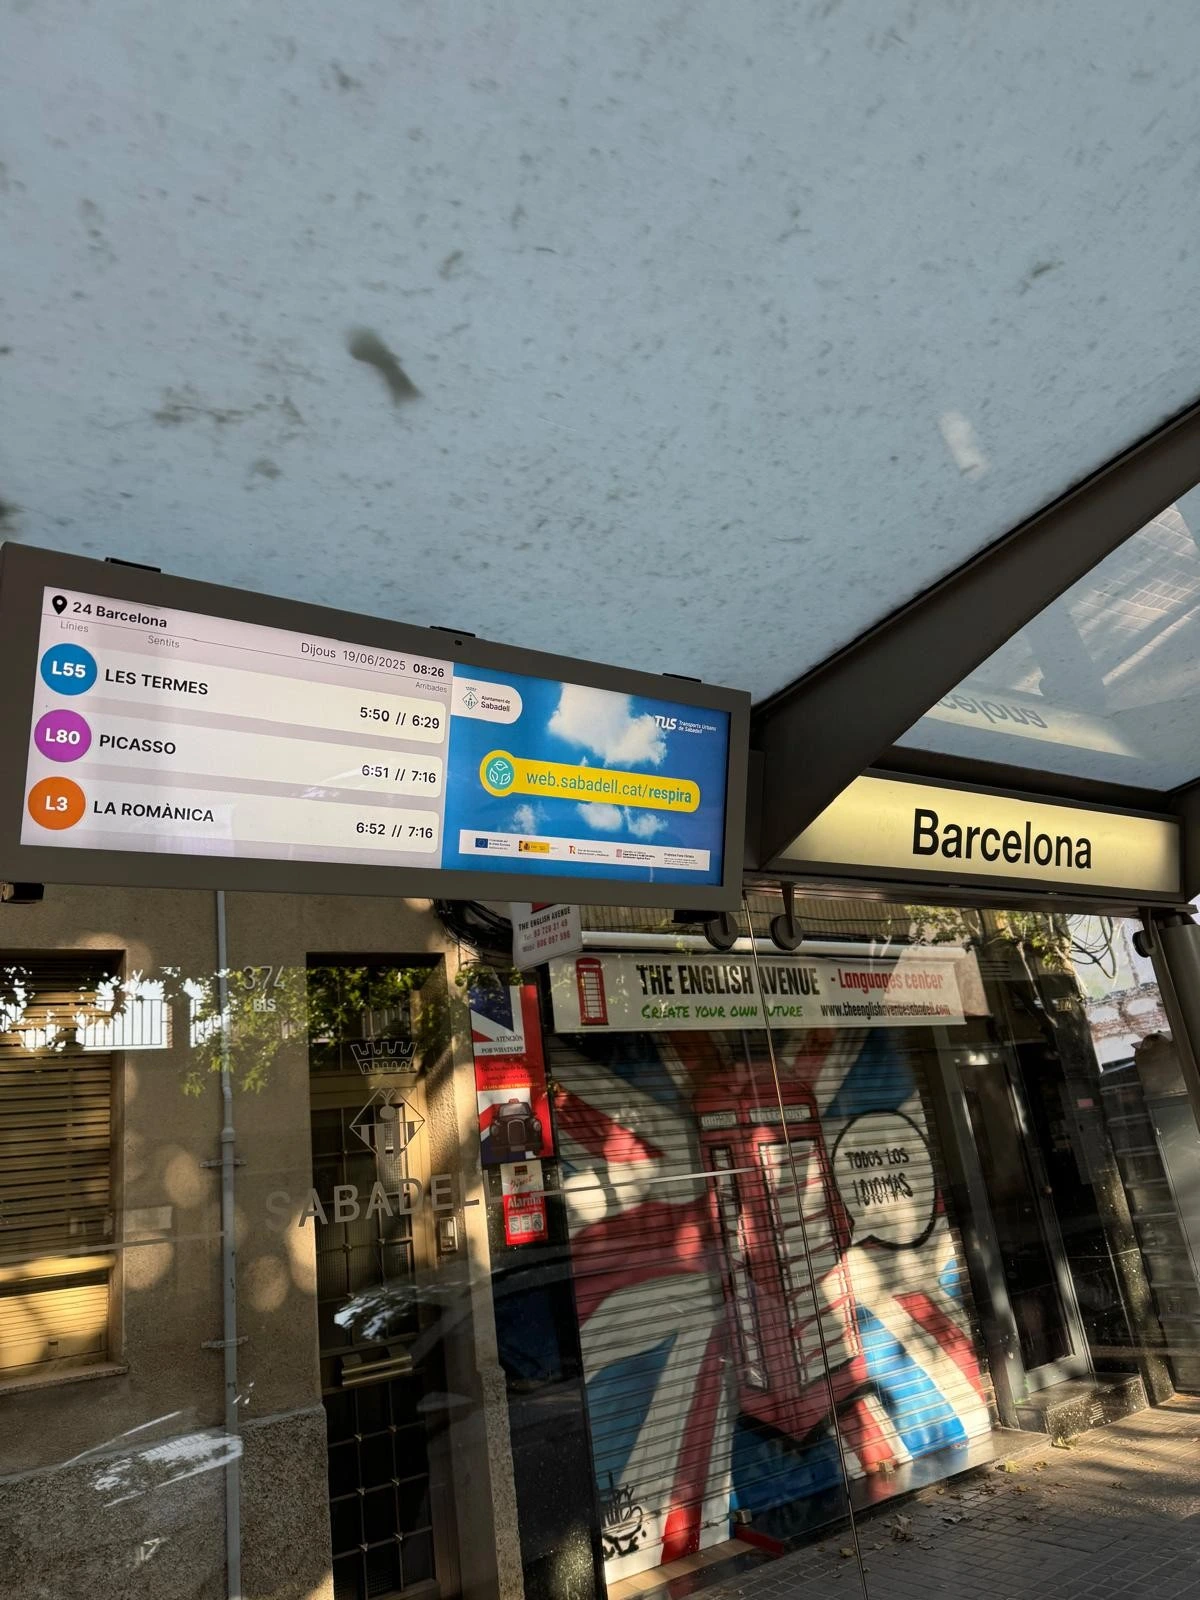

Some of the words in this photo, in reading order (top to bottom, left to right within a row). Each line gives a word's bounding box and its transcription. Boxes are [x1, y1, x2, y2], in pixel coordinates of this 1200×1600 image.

[73, 602, 92, 614] 24
[96, 606, 167, 628] Barcelona
[60, 621, 89, 633] Línies
[148, 635, 179, 648] Sentits
[52, 661, 86, 678] L55
[301, 642, 336, 658] Dijous
[343, 650, 406, 670] 19/06/2025
[413, 663, 445, 677] 08:26
[105, 669, 136, 685] LES
[141, 674, 208, 695] TERMES
[415, 681, 447, 693] Arribades
[481, 701, 511, 712] Sabadell
[360, 707, 390, 722] 5:50
[395, 712, 407, 725] //
[412, 715, 440, 729] 6:29
[654, 715, 677, 730] TUS
[45, 728, 81, 745] L80
[99, 734, 177, 755] PICASSO
[361, 764, 389, 778] 6:51
[394, 768, 406, 781] //
[411, 770, 436, 783] 7:16
[526, 772, 692, 804] web.sabadell.cat/respira
[45, 795, 68, 812] L3
[93, 801, 116, 815] LA
[121, 802, 215, 822] ROMÀNICA
[356, 822, 385, 835] 6:52
[391, 825, 402, 837] //
[408, 826, 433, 838] 7:16
[912, 808, 1092, 869] Barcelona
[519, 922, 529, 931] THE
[530, 914, 551, 928] ENGLISH
[551, 906, 571, 920] AVENUE
[243, 966, 286, 990] 374
[636, 964, 675, 995] THE
[677, 965, 754, 995] ENGLISH
[759, 966, 820, 995] AVENUE
[837, 968, 903, 994] Languages
[905, 970, 944, 989] center
[253, 998, 277, 1012] BIS
[641, 1005, 690, 1019] CREATE
[695, 1005, 727, 1018] YOUR
[730, 1005, 758, 1018] OWN
[767, 1005, 803, 1017] UTURE
[844, 1150, 883, 1169] TODOS
[885, 1147, 910, 1165] LOS
